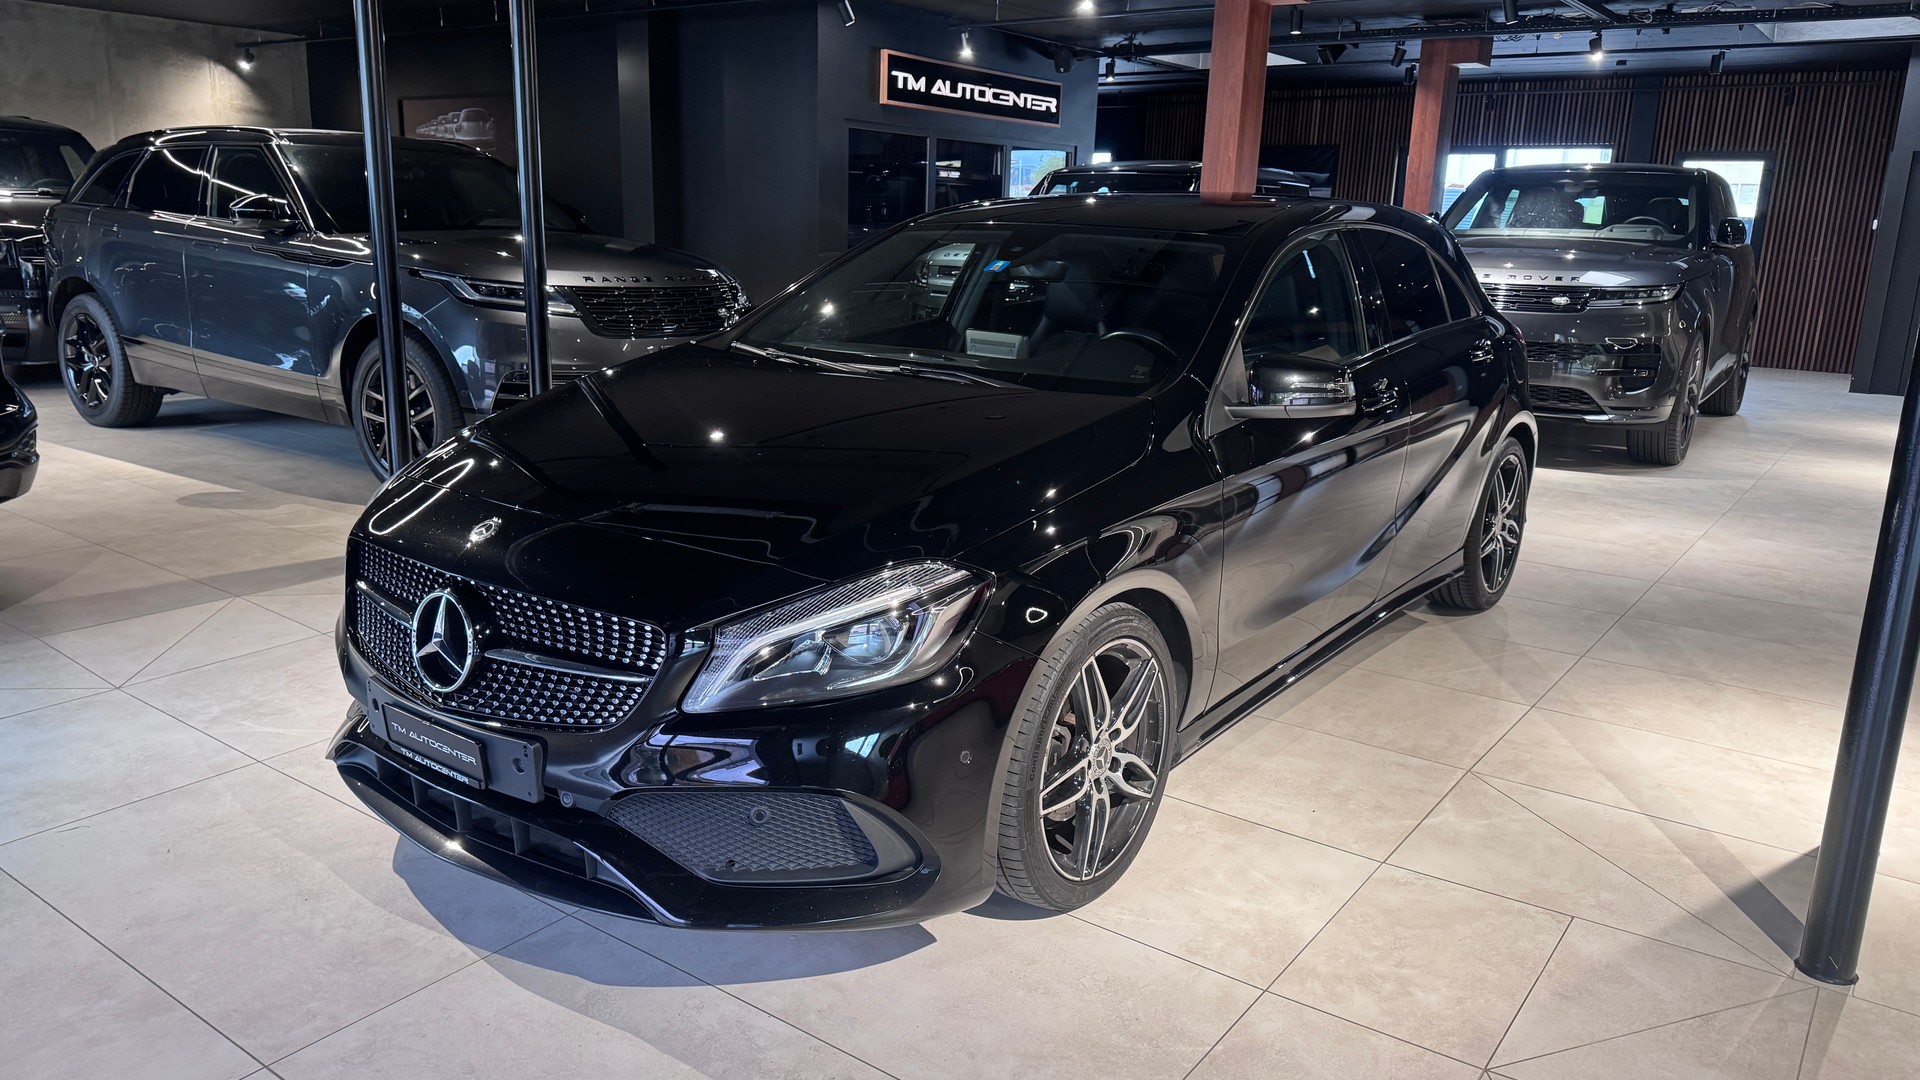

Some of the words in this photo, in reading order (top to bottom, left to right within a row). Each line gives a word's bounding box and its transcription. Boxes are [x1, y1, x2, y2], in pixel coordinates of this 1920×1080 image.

[891, 70, 926, 92] TM
[930, 78, 1058, 113] AUTOCENTER
[1507, 274, 1581, 282] ROVER
[391, 722, 407, 735] TM
[409, 731, 477, 766] AUTOCENTER
[400, 747, 414, 759] TM
[414, 755, 470, 785] AUTOCENTER
